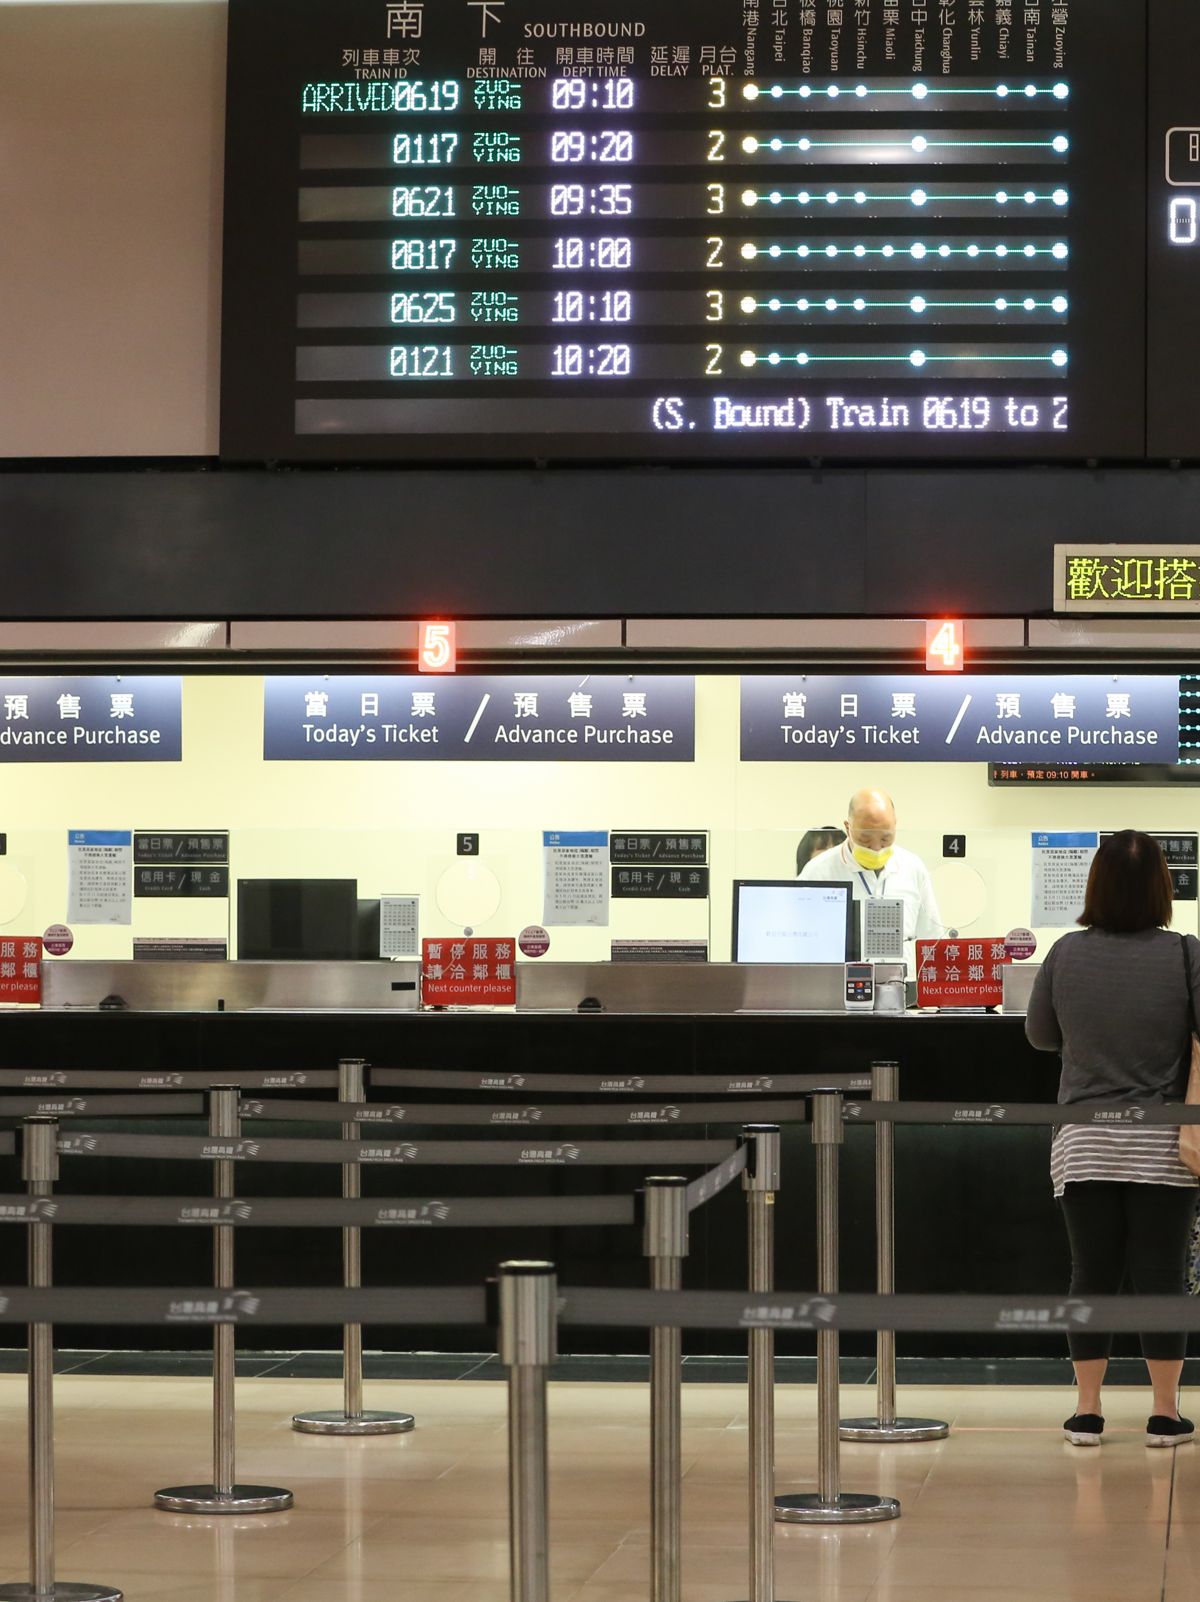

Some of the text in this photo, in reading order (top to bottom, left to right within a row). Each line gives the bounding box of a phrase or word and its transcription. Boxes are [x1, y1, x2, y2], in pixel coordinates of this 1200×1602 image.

[386, 1, 503, 38] 南下
[525, 23, 645, 37] SOUTHBOUND
[343, 46, 736, 67] 列車車次 開往 開車時間 延遲 月台
[744, 28, 757, 76] Nangang
[773, 28, 786, 62] Taipei
[801, 29, 813, 74] Banqiao
[831, 28, 841, 71] Taoyuan
[857, 28, 867, 69] Hsinchu
[885, 28, 896, 60] Miaoli
[912, 28, 925, 72] Taichung
[940, 28, 952, 74] Changhua
[970, 27, 981, 60] Yunlin
[998, 28, 1009, 59] Chiayi
[1027, 27, 1037, 62] Tainan
[1053, 26, 1066, 69] Zuoying
[354, 65, 735, 79] TRAIN ID DESTINATION DEPT TIME DELAY PLAT.
[473, 79, 522, 94] ZUO-
[303, 80, 460, 113] ARRIVED 0619
[473, 95, 522, 110] YING
[551, 78, 635, 110] 09:10
[708, 77, 727, 108] 3
[392, 133, 459, 164] 0117
[473, 132, 521, 147] ZUO-
[550, 131, 634, 163] 09:20
[707, 131, 726, 161] 2
[472, 148, 521, 163] YING
[391, 186, 457, 217] 0621
[472, 185, 520, 200] ZUO-
[550, 184, 633, 215] 09:35
[707, 184, 725, 214] 3
[472, 201, 520, 216] YING
[391, 239, 457, 270] 0817
[471, 239, 519, 253] ZUO-
[471, 254, 519, 269] YING
[551, 237, 632, 269] 10:00
[706, 237, 724, 268] 2
[390, 292, 456, 324] 0625
[470, 292, 519, 306] ZUO-
[470, 307, 519, 322] YING
[550, 290, 631, 323] 10:10
[706, 290, 723, 321] 3
[389, 346, 455, 377] 0121
[470, 345, 519, 360] ZUO-
[550, 344, 631, 376] 10:20
[705, 343, 723, 375] 2
[470, 361, 519, 376] YING
[652, 396, 697, 430] (S.
[713, 397, 811, 430] Bound)
[826, 397, 910, 428] Train
[922, 397, 991, 429] 0619
[1004, 399, 1039, 428] to
[422, 624, 451, 668] 5
[929, 621, 961, 666] 4
[4, 693, 135, 720] 預售票
[304, 690, 648, 719] 當日票 預售票
[782, 691, 1131, 719] 當日票 預售票
[0, 727, 161, 745] dvance Purchase
[302, 723, 674, 747] Today's Ticket Advance Purchase
[780, 724, 1159, 748] Today's Ticket Advance Purchase
[1046, 771, 1069, 780] 09:10
[462, 836, 473, 852] 5
[614, 837, 702, 851] 當日票 預售票
[948, 838, 960, 853] 4
[618, 871, 701, 884] 信用卡 現金
[426, 942, 512, 960] 暫停服務
[426, 964, 512, 981] 請洽鄰櫃
[428, 983, 512, 995] Next counter please
